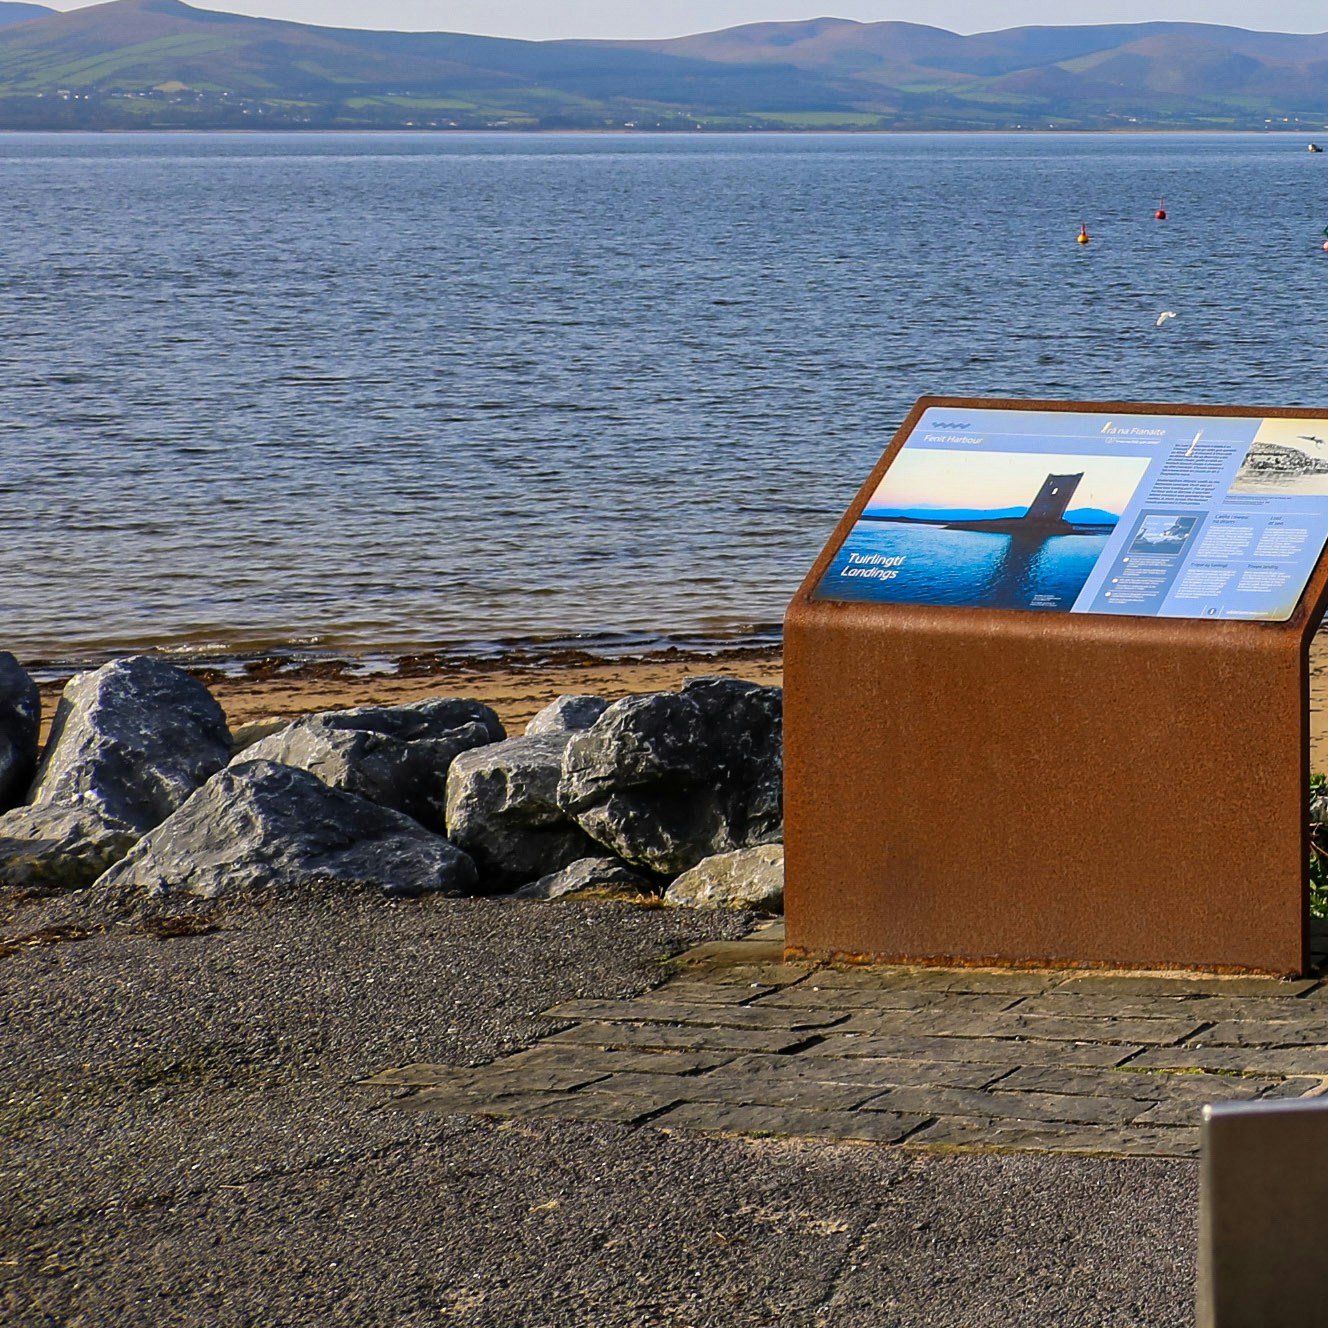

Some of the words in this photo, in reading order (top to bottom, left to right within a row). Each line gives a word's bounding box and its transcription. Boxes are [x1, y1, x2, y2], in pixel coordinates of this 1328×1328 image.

[924, 433, 948, 443] Fenit
[948, 435, 984, 445] Harbour
[840, 565, 899, 581] Landings
